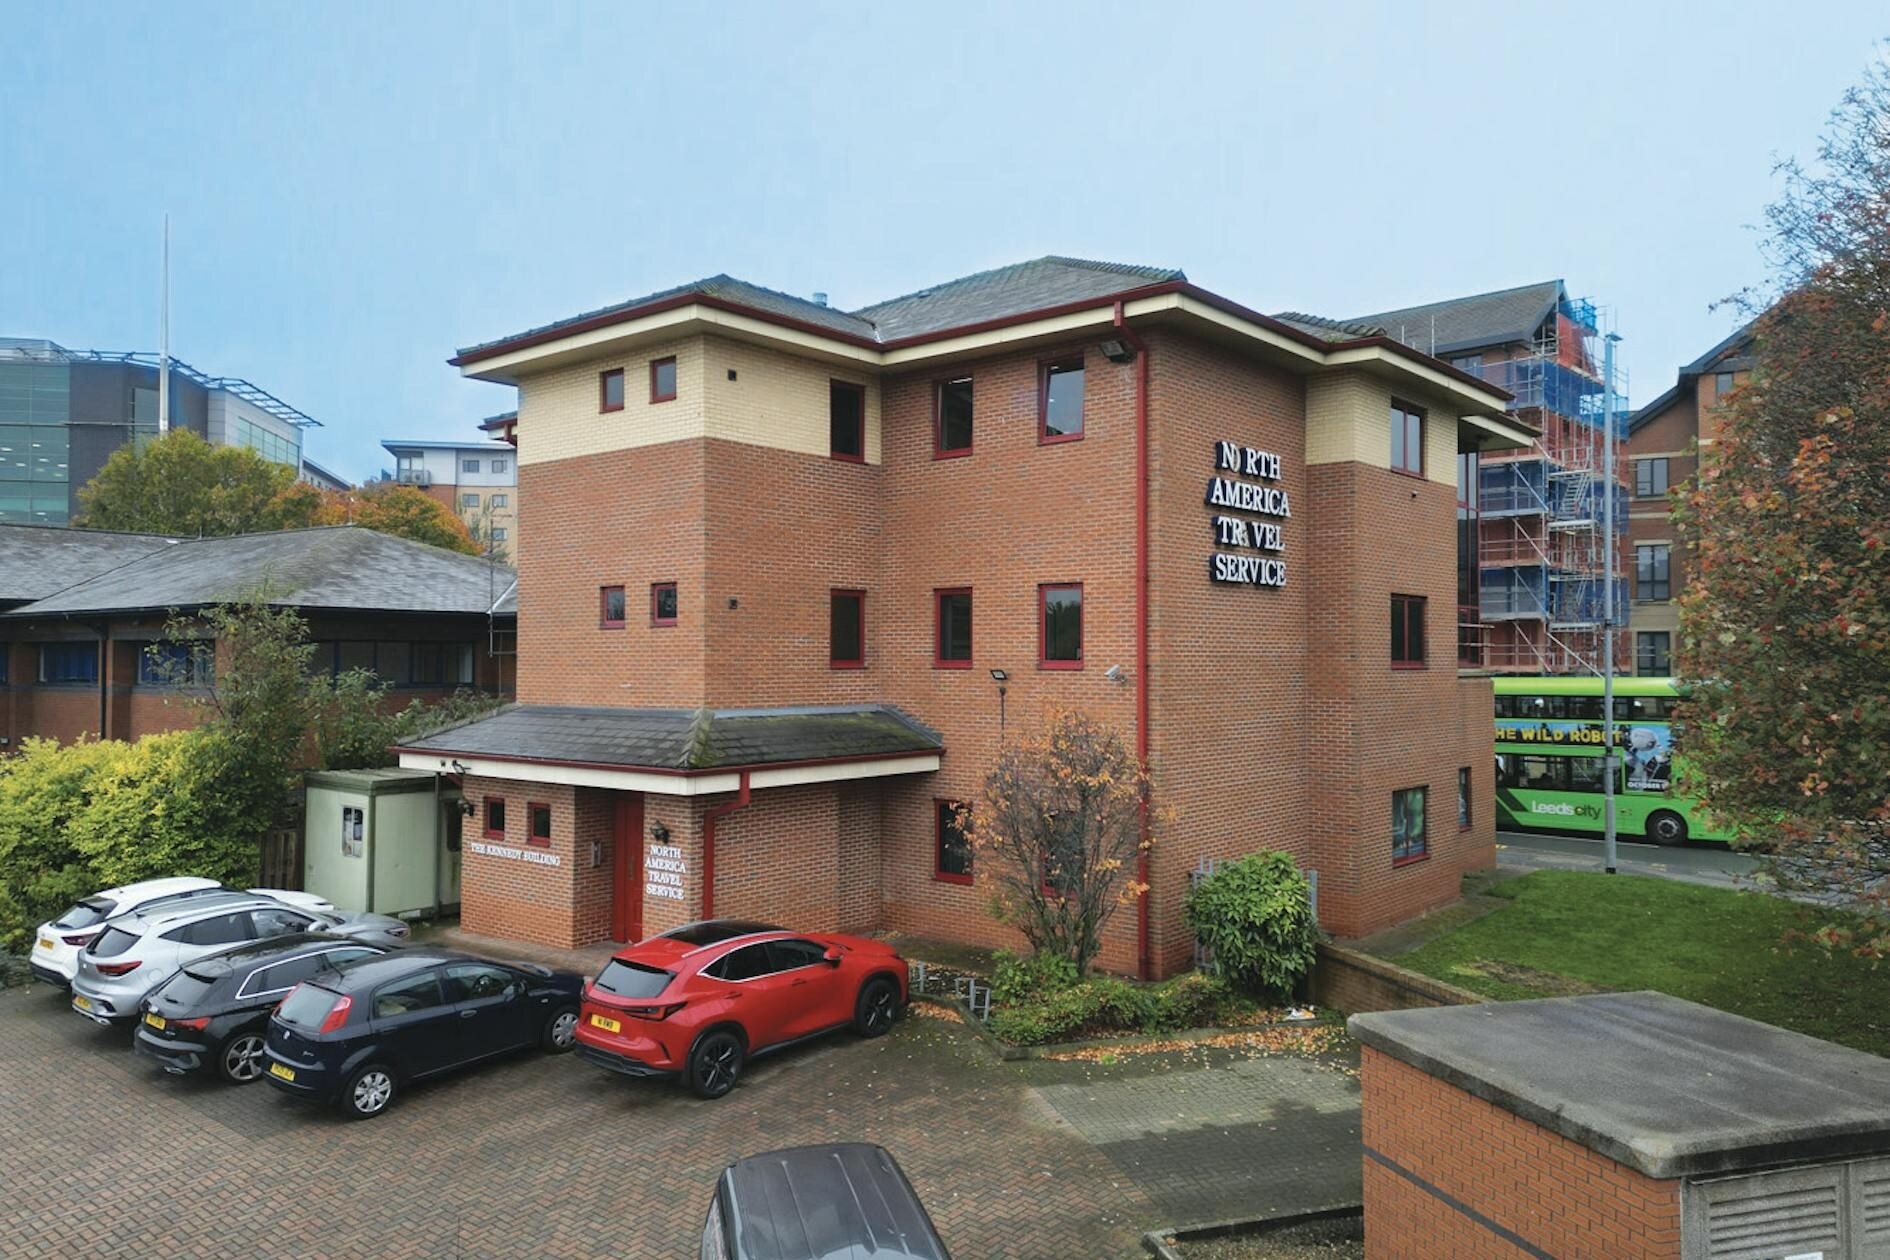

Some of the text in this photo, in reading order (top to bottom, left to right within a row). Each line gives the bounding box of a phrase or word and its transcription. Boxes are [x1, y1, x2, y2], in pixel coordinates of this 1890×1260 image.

[1210, 477, 1292, 518] AMERICA
[1214, 553, 1287, 587] SERVICE
[1521, 727, 1564, 741] WILD
[486, 844, 522, 860] KENNEDY
[523, 850, 561, 867] BUILDING
[649, 844, 683, 859] NORTH
[644, 857, 687, 874] AMERICA
[647, 870, 683, 886] TRAVEL
[646, 883, 686, 900] SERVICE
